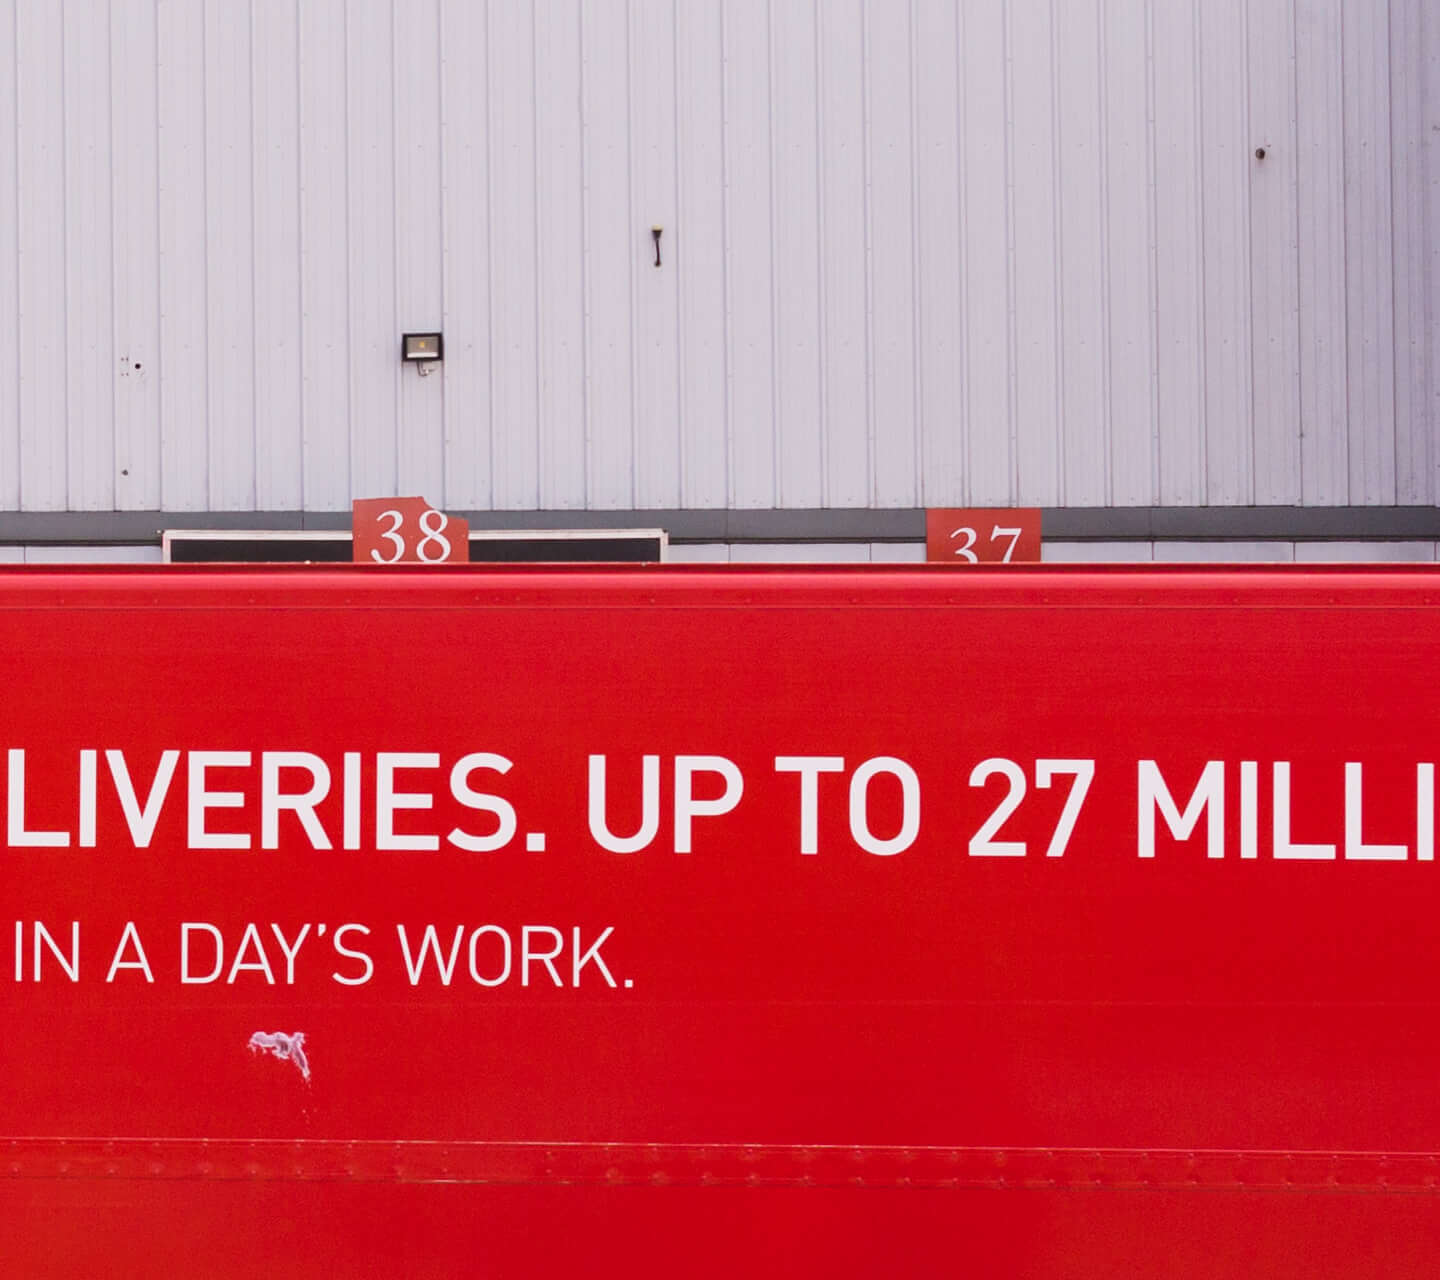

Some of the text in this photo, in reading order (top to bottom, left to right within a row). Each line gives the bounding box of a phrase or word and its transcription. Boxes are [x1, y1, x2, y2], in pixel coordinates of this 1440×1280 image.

[371, 509, 452, 563] 38
[950, 526, 1022, 563] 37
[588, 754, 744, 854] UP
[775, 756, 921, 856] TO
[968, 757, 1095, 857] 27
[15, 920, 80, 983] IN
[105, 921, 155, 983] A
[180, 922, 374, 986] DAY'S
[396, 924, 634, 988] WORK.
